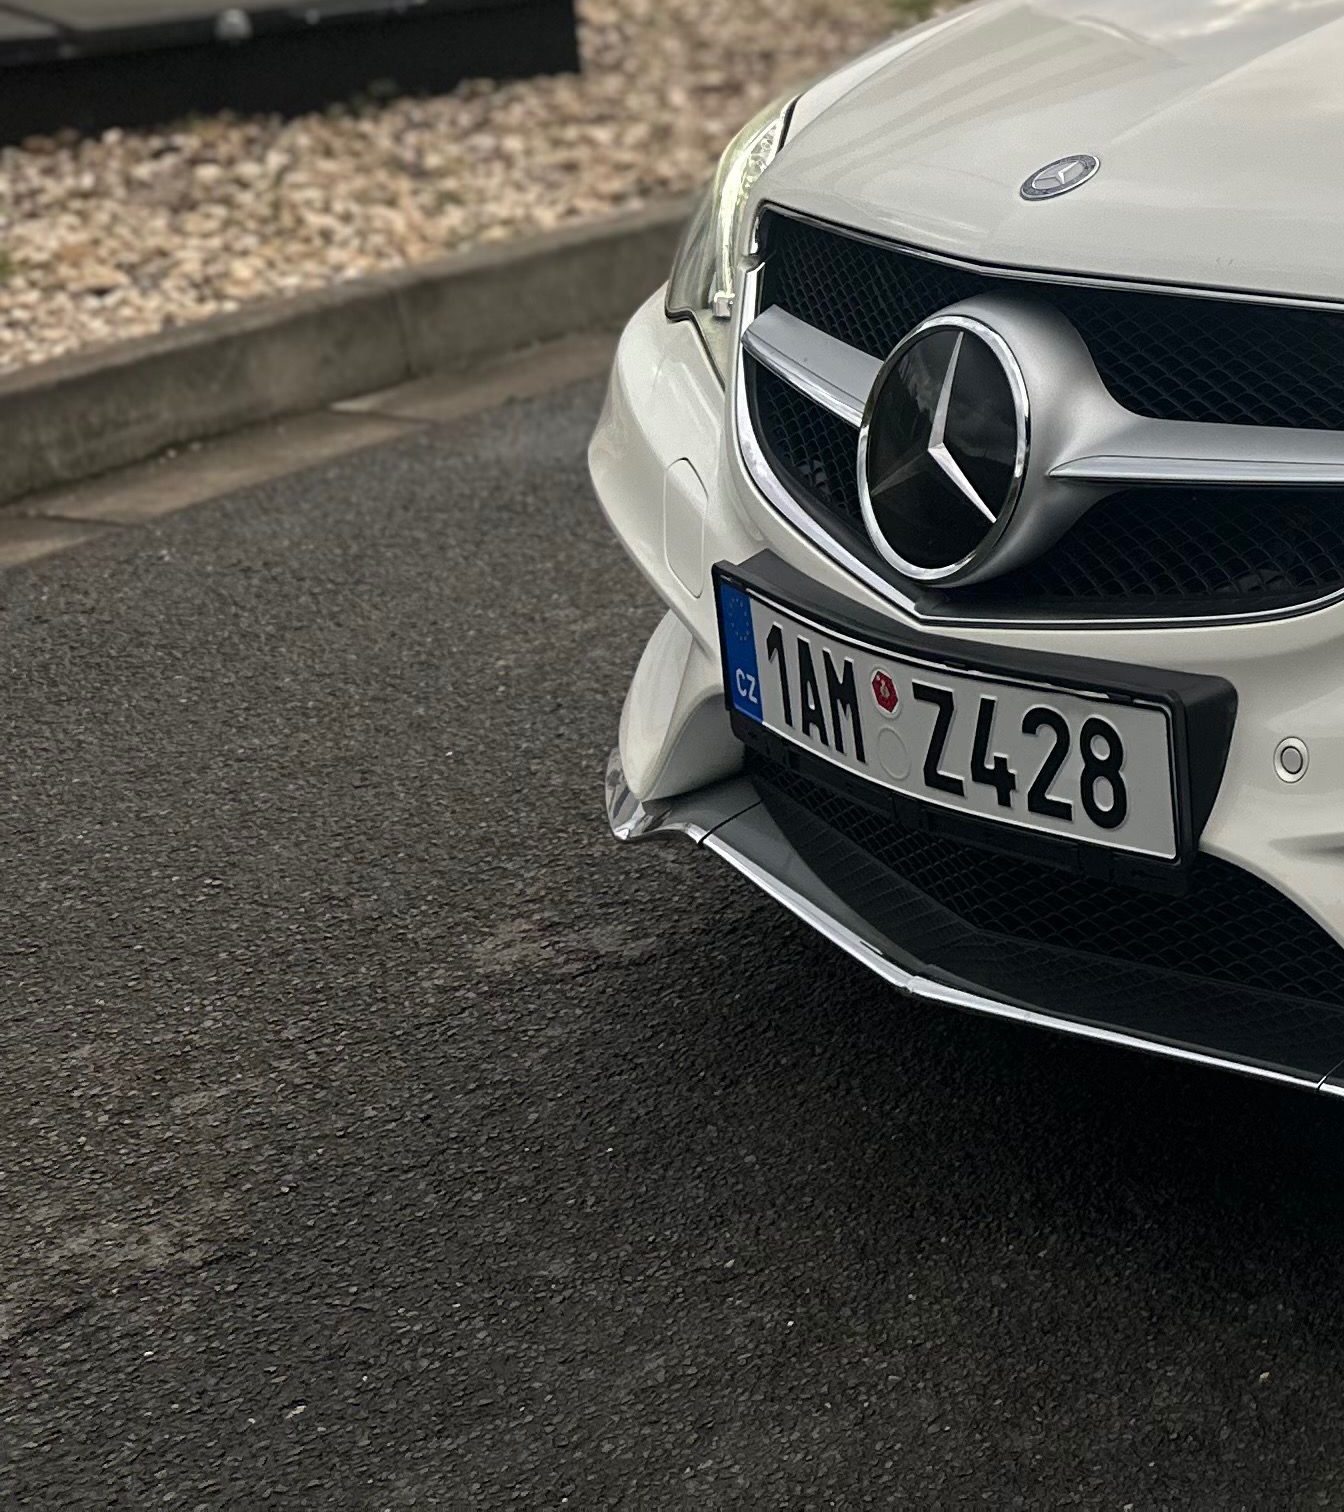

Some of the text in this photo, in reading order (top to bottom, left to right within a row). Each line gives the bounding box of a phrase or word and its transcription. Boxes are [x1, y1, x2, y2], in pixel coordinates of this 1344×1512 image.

[735, 667, 759, 704] CZ
[766, 622, 1127, 829] 1AM Z428
